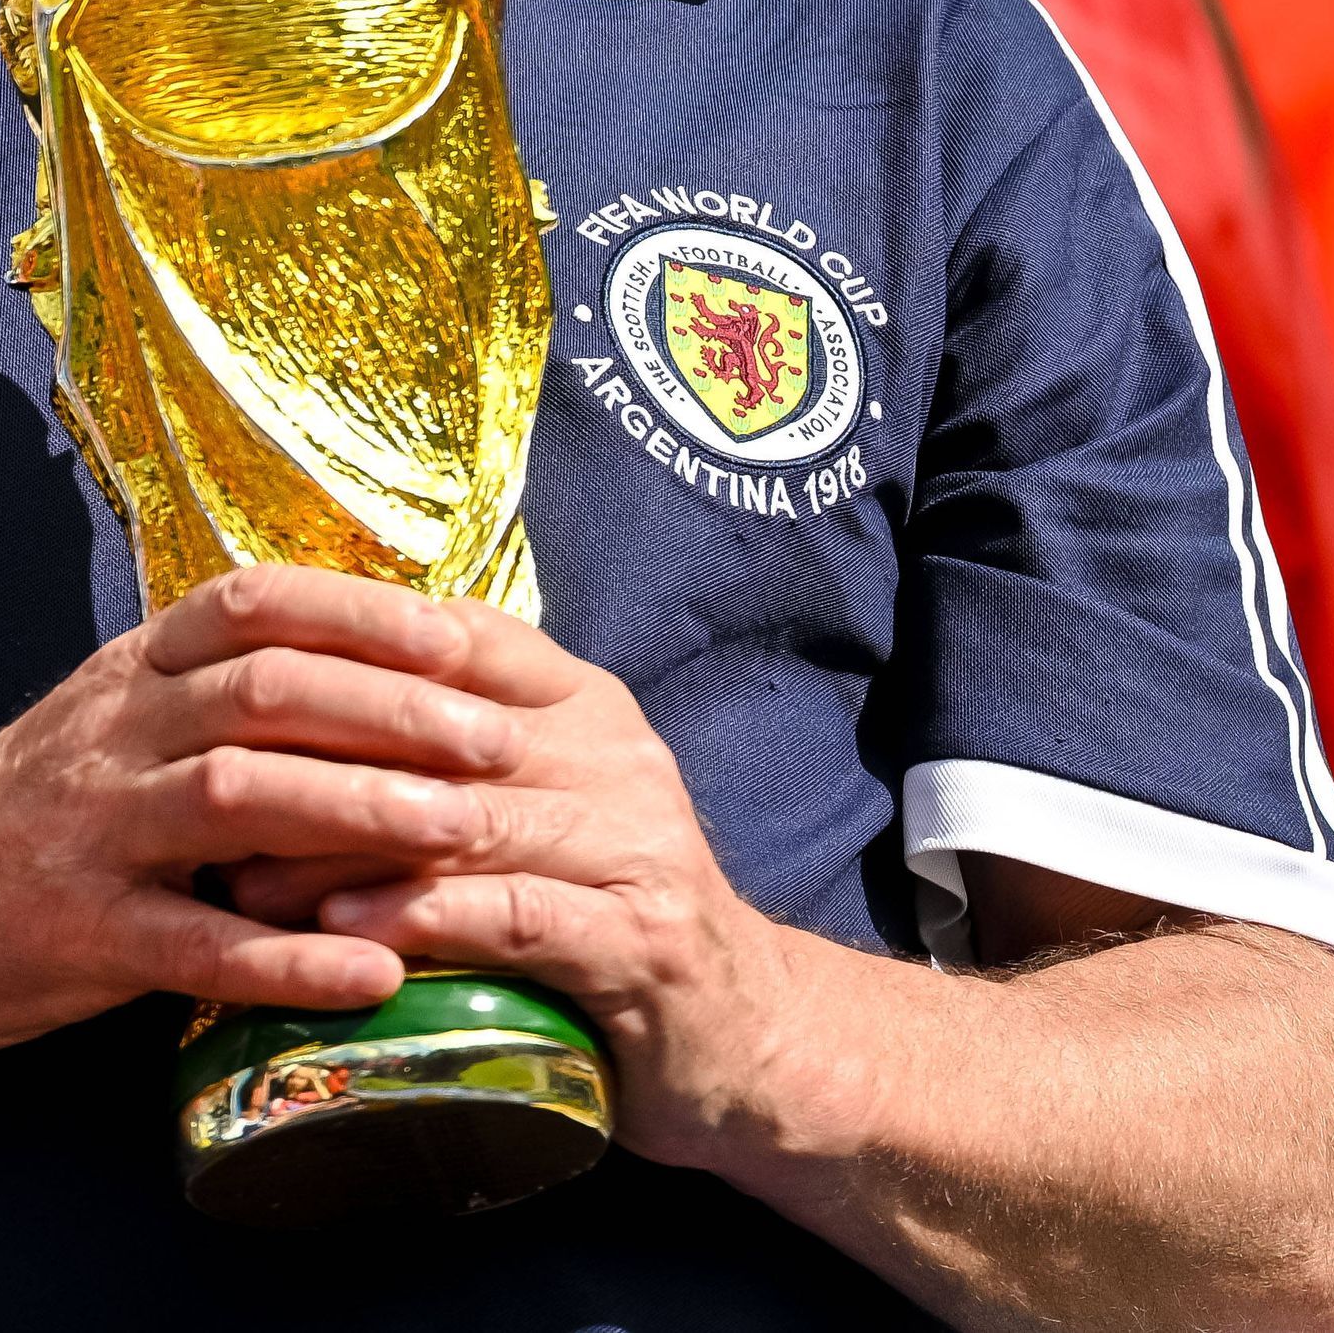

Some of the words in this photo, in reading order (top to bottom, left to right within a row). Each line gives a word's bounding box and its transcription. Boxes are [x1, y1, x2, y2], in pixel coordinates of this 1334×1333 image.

[576, 193, 660, 247] FIFA
[650, 185, 816, 250] WORLD
[819, 251, 888, 327] CUP
[622, 260, 651, 352] SCOTTISH
[678, 246, 790, 289] FOOTBALL
[645, 361, 678, 398] THE
[800, 318, 849, 442] ASSOCIATION
[571, 357, 798, 519] ARGENTINA
[803, 445, 867, 514] 1978
